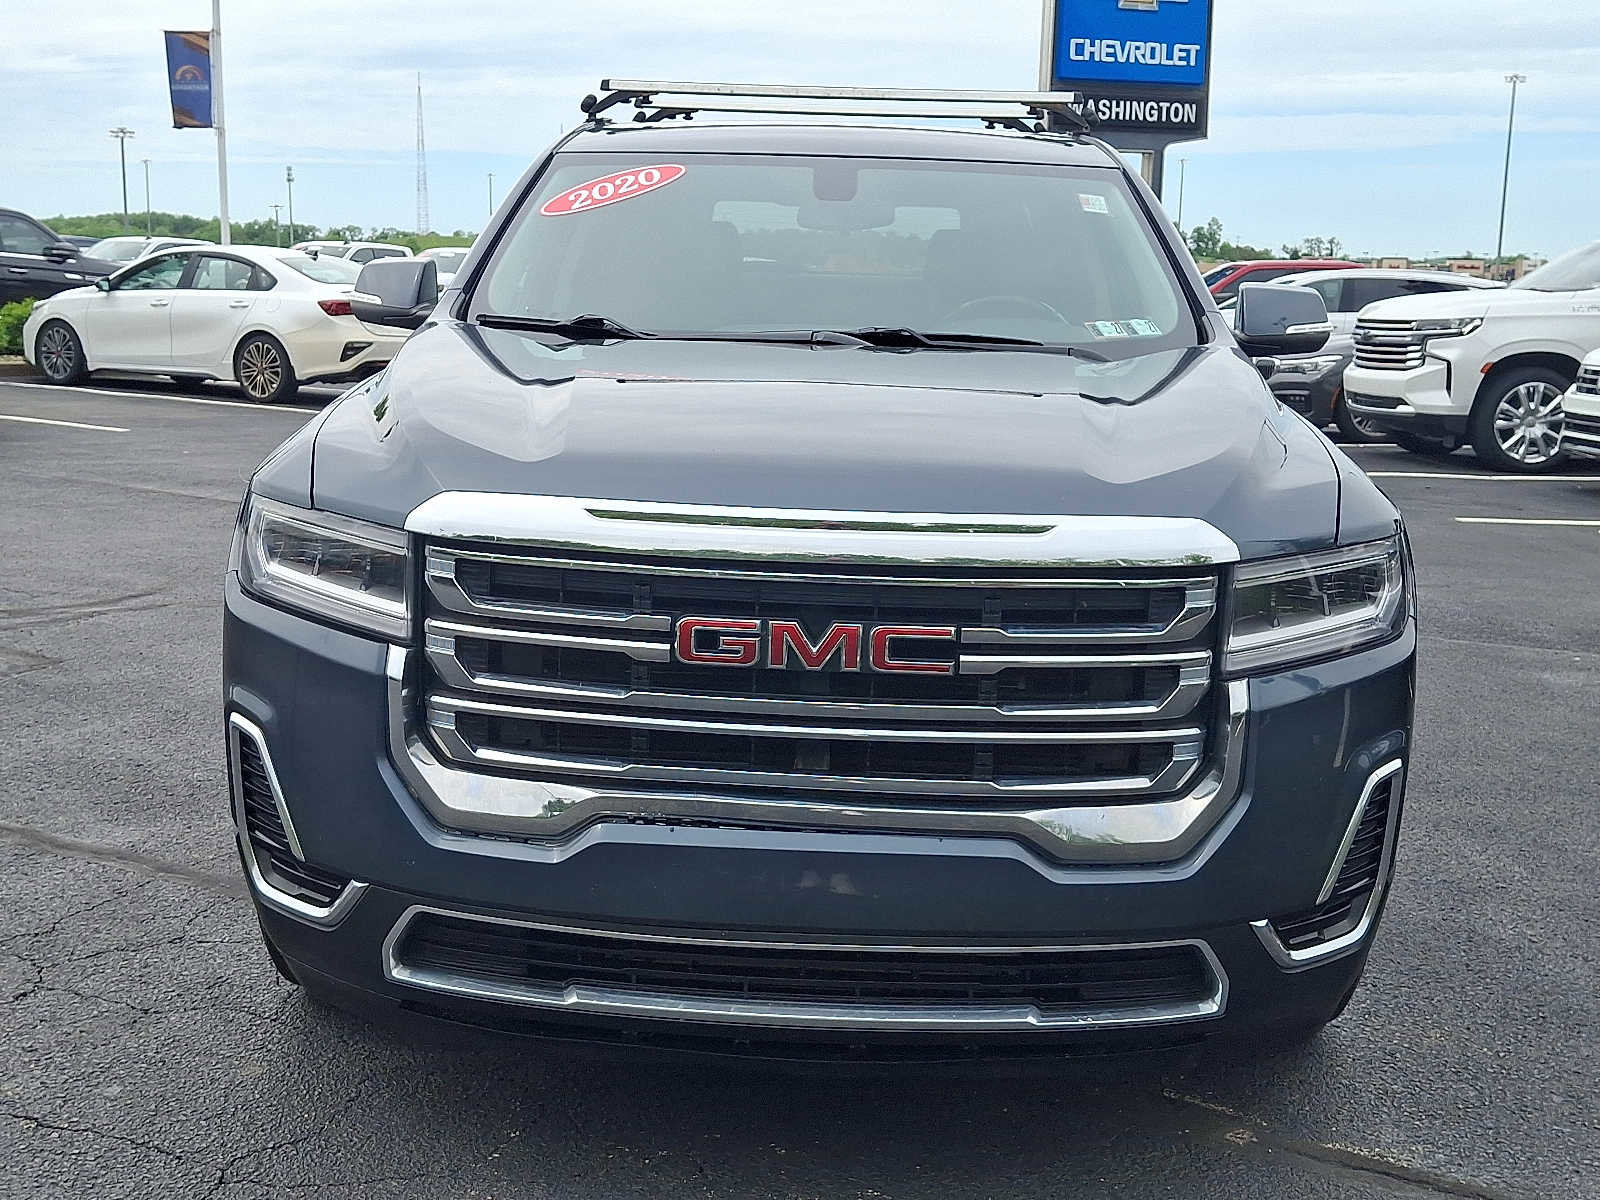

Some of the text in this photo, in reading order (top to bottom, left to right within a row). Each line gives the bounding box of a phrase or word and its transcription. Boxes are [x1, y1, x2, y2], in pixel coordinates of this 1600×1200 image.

[1069, 38, 1200, 66] CHEVROLET
[568, 168, 661, 210] 2020
[675, 614, 956, 675] GMC
